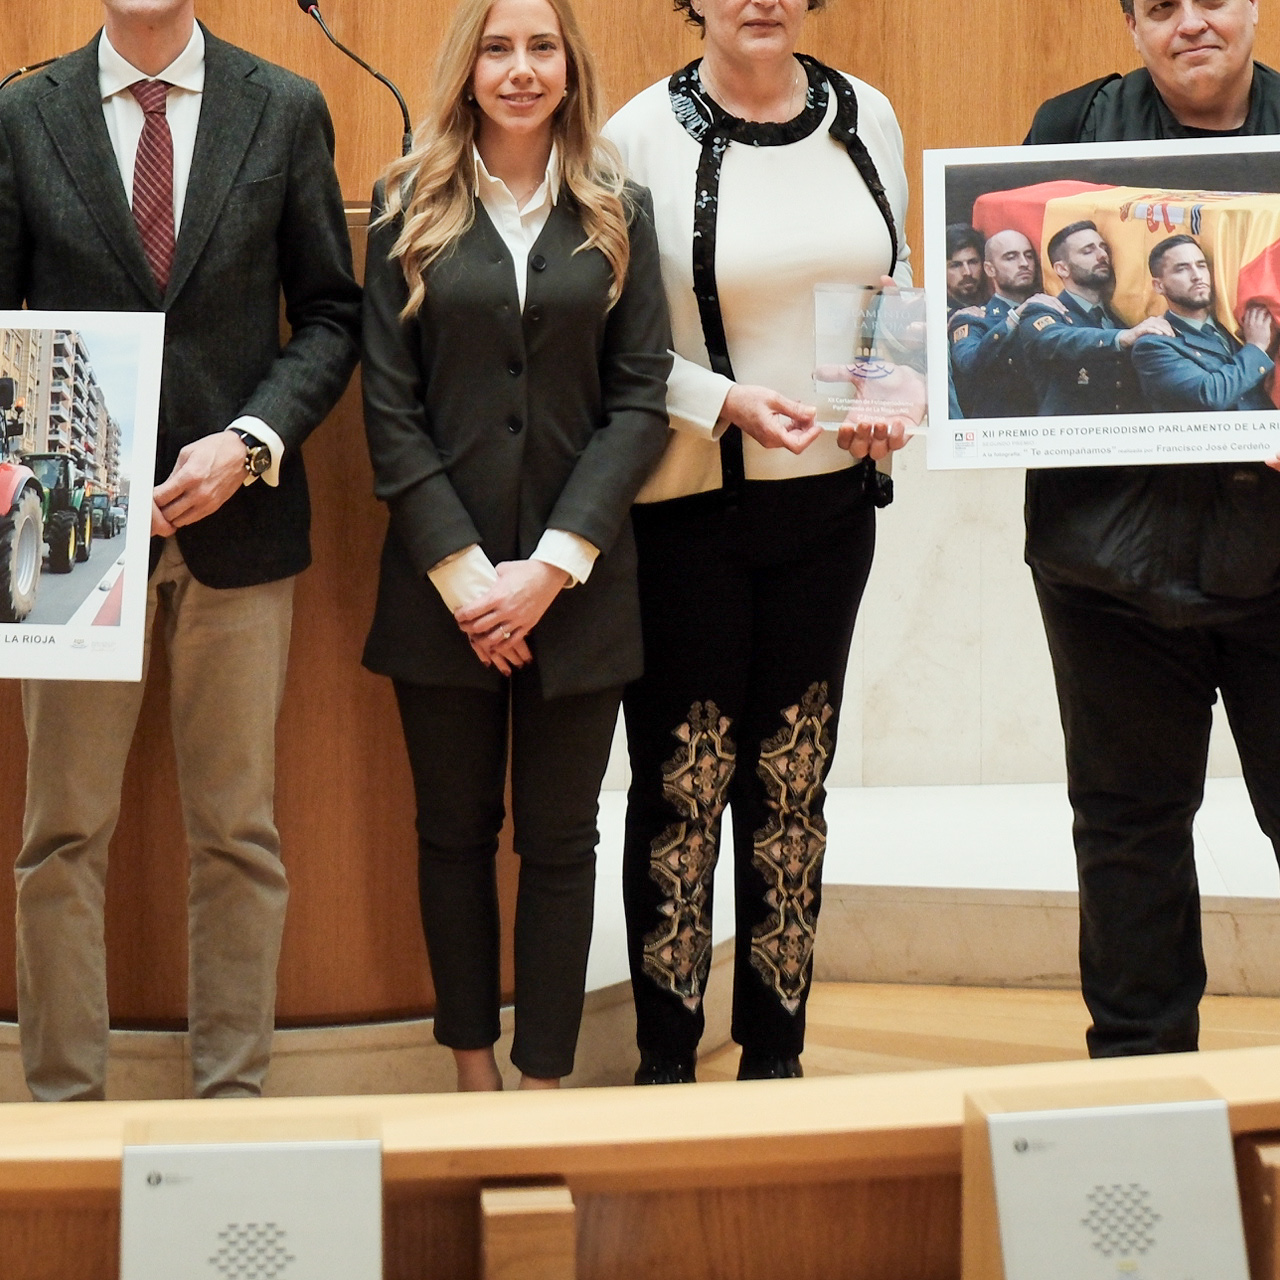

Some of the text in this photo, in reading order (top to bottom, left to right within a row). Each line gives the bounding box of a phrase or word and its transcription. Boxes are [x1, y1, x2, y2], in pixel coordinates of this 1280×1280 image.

[982, 430, 995, 438] XII
[999, 429, 1039, 437] PREMIO
[1043, 428, 1056, 436] DE
[1060, 426, 1155, 436] FOTOPERIODISMO
[1159, 423, 1231, 433] PARLAMENTO
[1235, 423, 1248, 432] DE
[1156, 444, 1202, 452] Francisco
[1206, 443, 1228, 452] José
[1230, 442, 1271, 450] Cerdeño
[5, 635, 19, 643] LA
[23, 635, 56, 644] RIOJA
